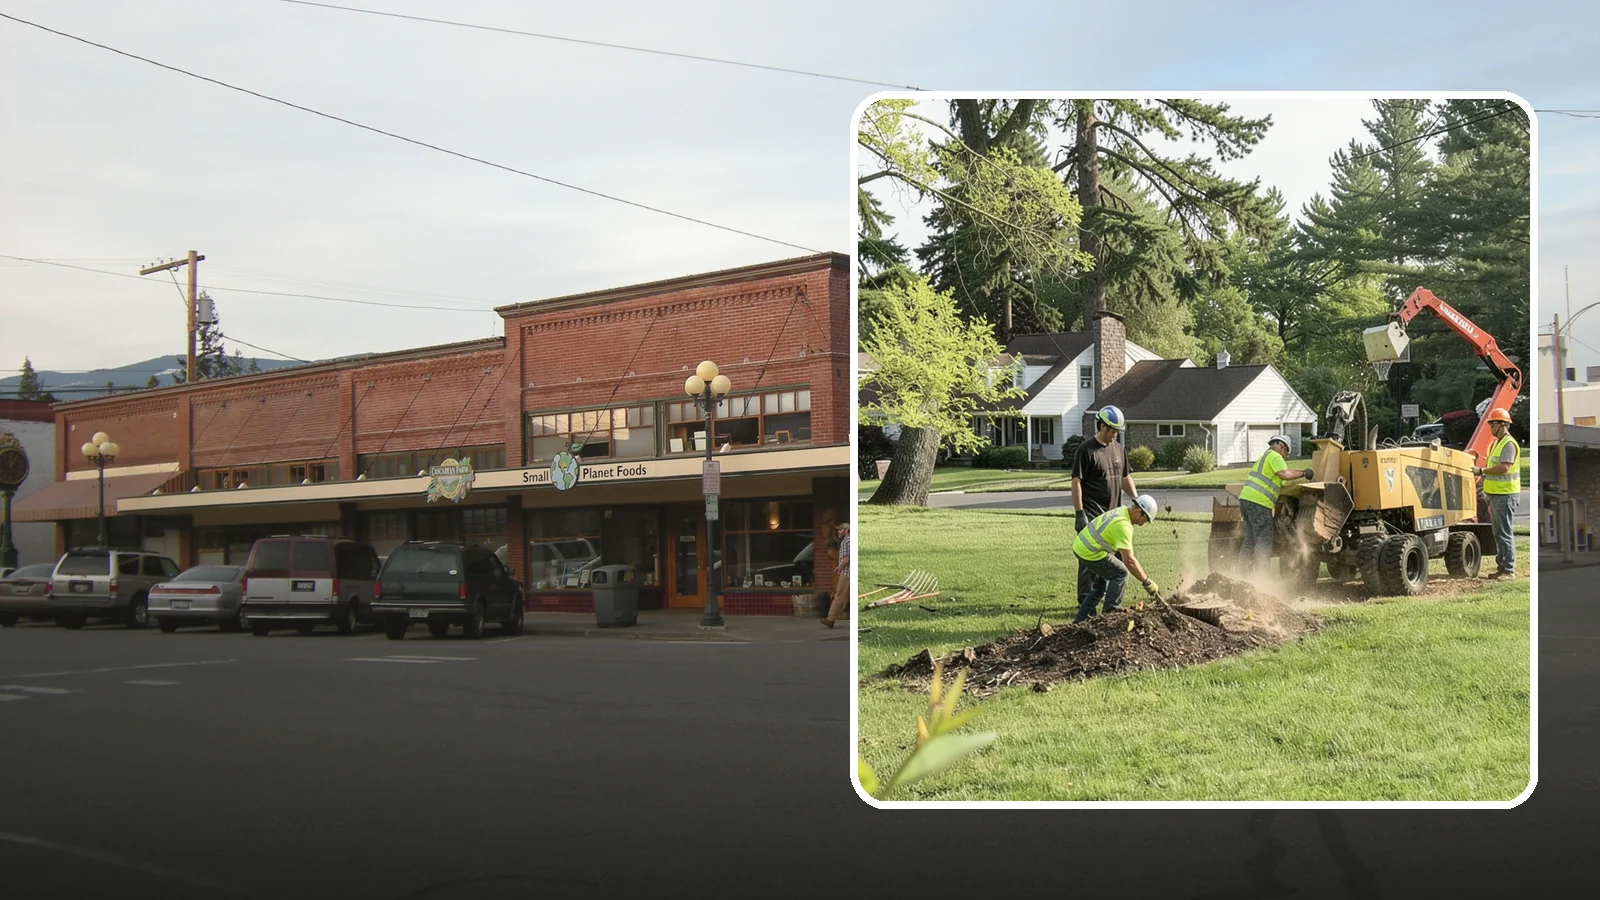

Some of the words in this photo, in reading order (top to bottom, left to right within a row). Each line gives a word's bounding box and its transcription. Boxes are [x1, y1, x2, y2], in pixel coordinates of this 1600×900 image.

[523, 470, 549, 483] Small
[582, 467, 614, 479] Planet
[617, 464, 647, 477] Foods
